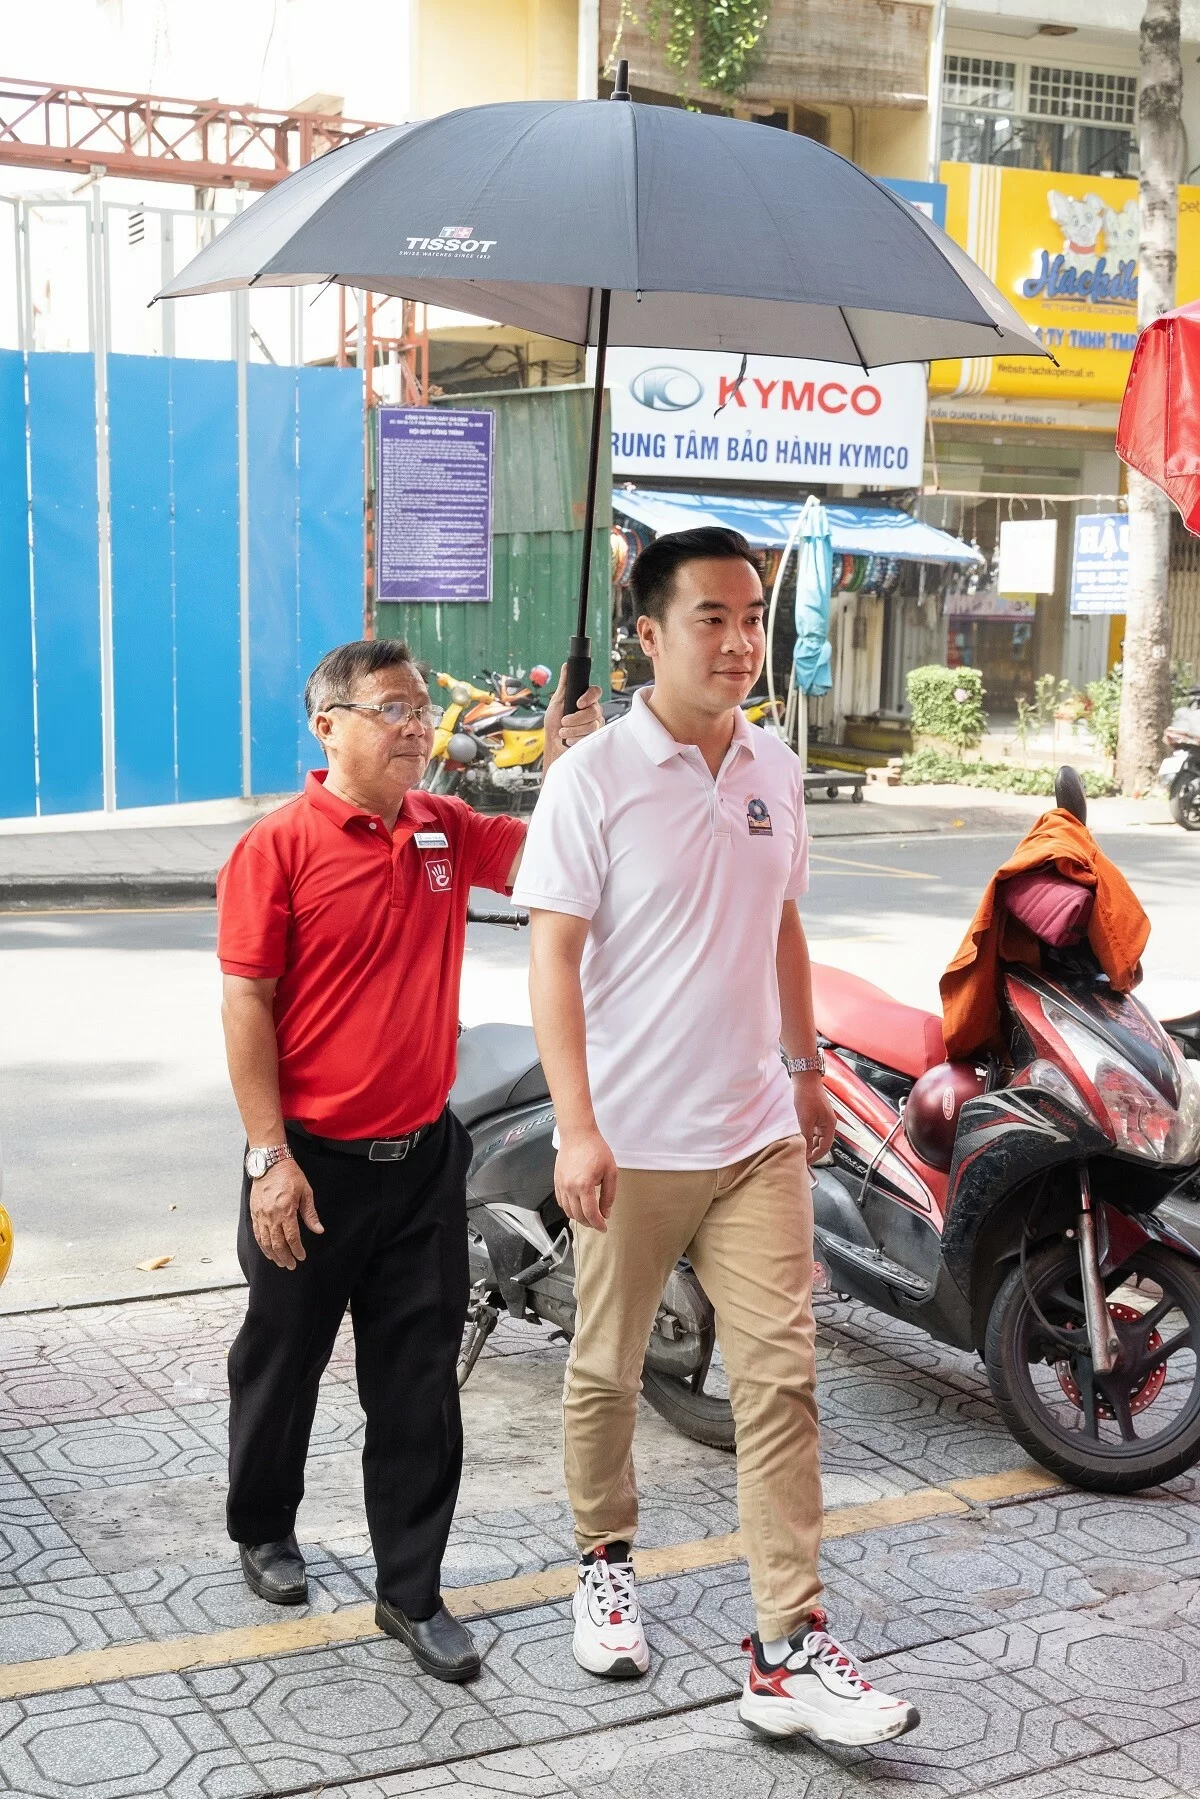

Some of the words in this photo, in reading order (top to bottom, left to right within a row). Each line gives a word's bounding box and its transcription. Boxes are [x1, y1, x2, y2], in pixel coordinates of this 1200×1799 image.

[406, 237, 498, 253] TISSOT
[1022, 249, 1138, 303] Hachik
[718, 376, 882, 416] KYMCO
[611, 432, 666, 458] RUNG
[674, 429, 719, 460] TÂM
[727, 429, 768, 463] BẢO
[776, 435, 832, 466] HÀNH
[840, 443, 909, 470] KYMCO
[834, 1147, 868, 1174] PGM-F
